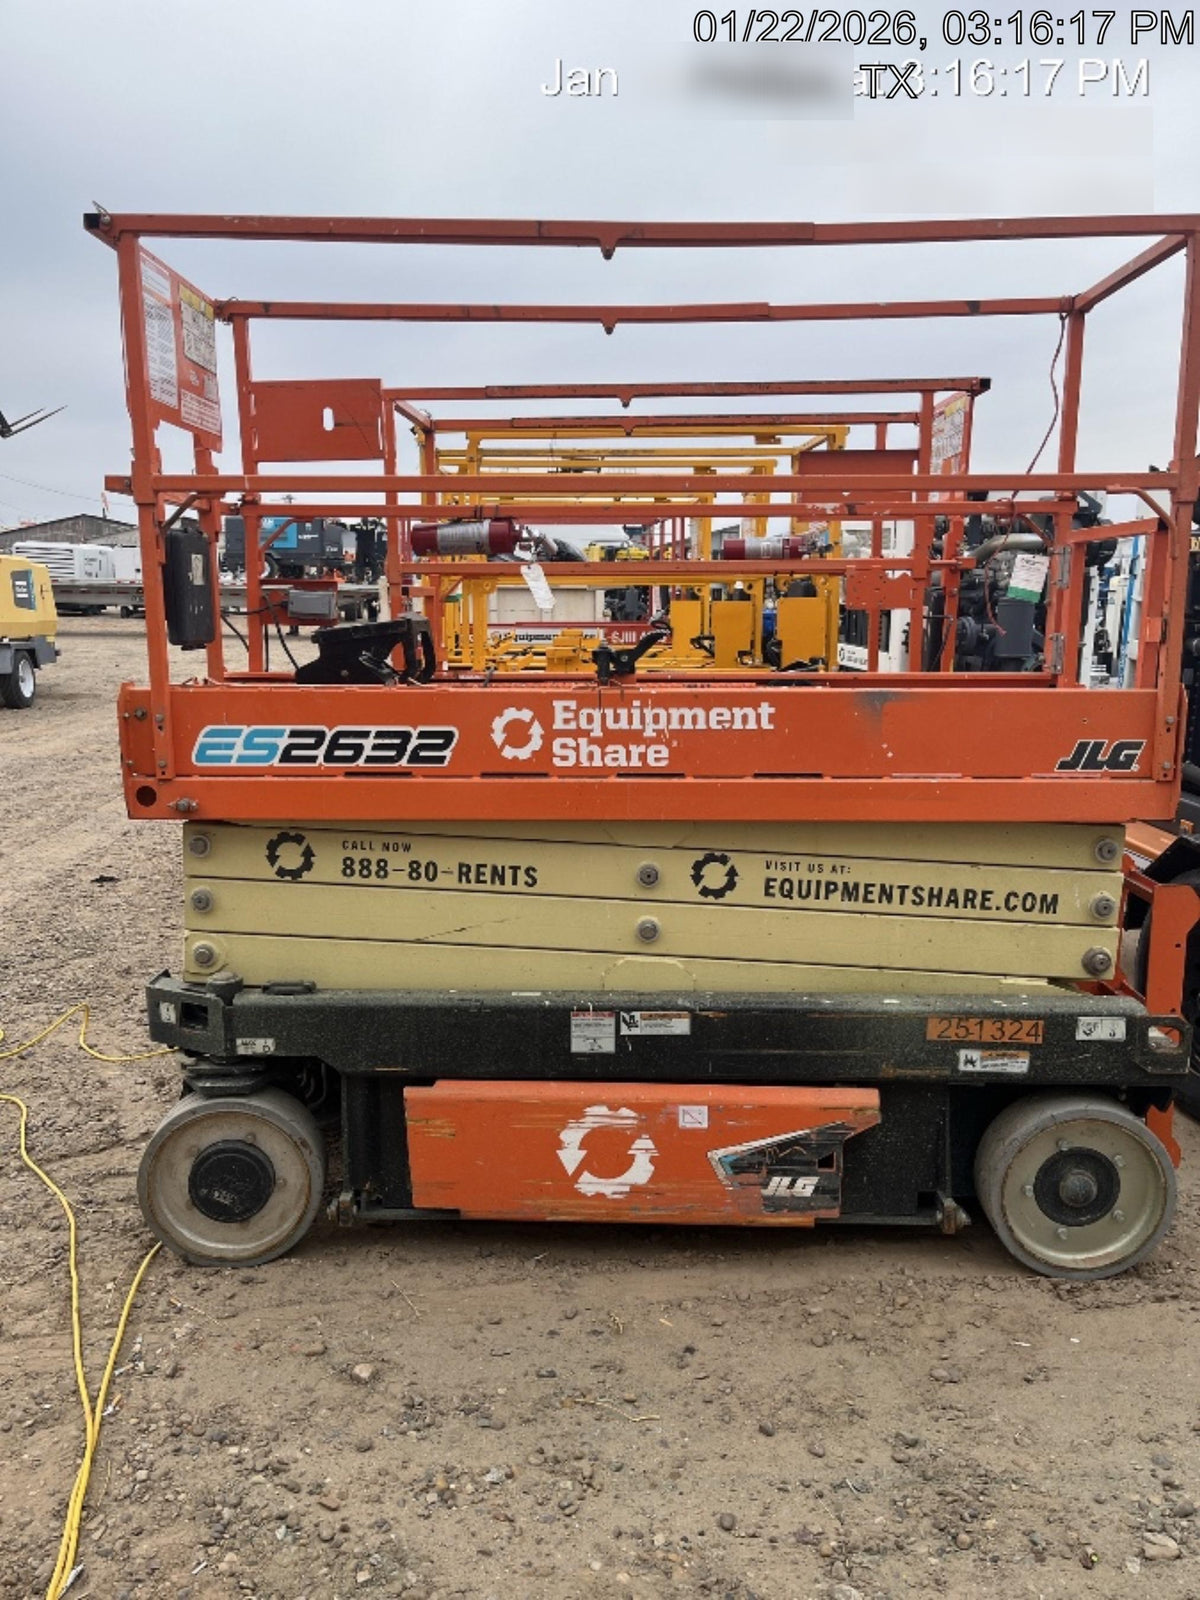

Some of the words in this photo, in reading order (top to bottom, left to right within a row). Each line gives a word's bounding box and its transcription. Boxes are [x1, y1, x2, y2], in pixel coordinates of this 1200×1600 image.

[552, 700, 776, 737] Equipment
[191, 725, 459, 767] ES2632
[552, 737, 670, 767] Share
[1053, 739, 1147, 772] JLG
[342, 840, 375, 851] CALL
[382, 842, 412, 853] NOW
[341, 856, 539, 888] 888-80-RENTS
[765, 860, 801, 872] VISIT
[808, 863, 825, 874] US
[830, 865, 852, 875] AT:
[764, 877, 1060, 915] EQUIPMENTSHARE.COM
[760, 1176, 820, 1197] JLG
